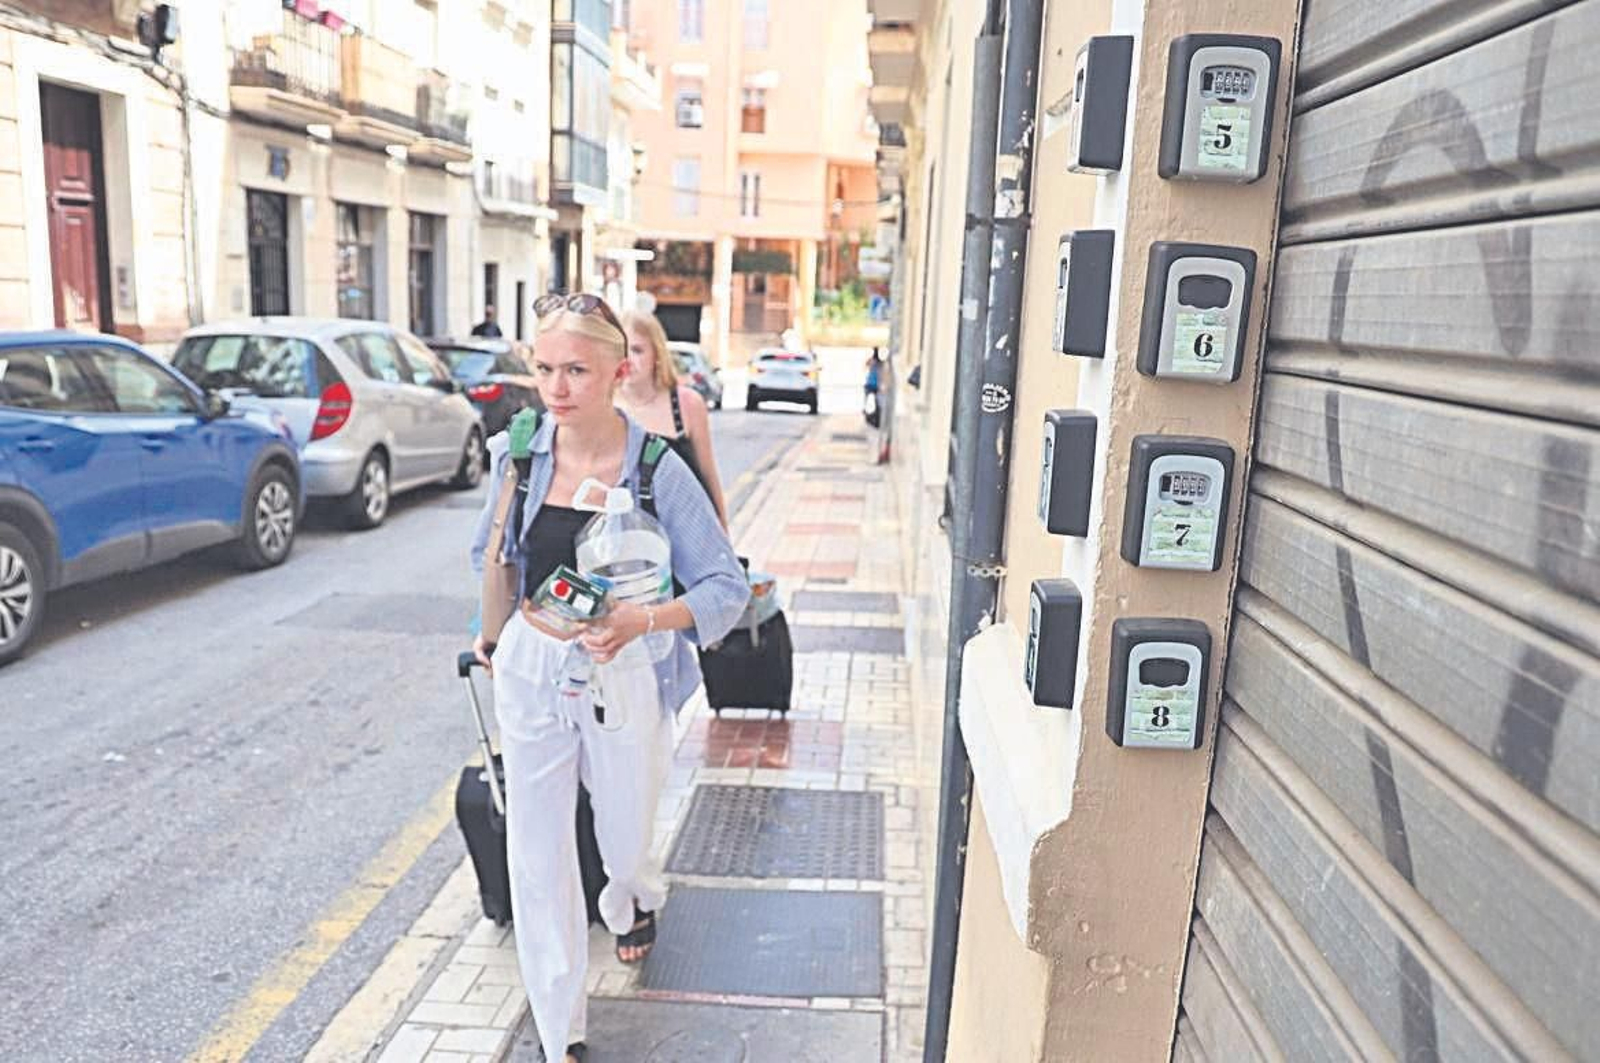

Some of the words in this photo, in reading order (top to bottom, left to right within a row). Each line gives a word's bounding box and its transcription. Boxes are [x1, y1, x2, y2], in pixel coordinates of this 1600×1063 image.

[1213, 123, 1232, 149] 5
[1193, 332, 1213, 357] 6
[1174, 523, 1192, 547] 7
[1151, 705, 1170, 727] 8
